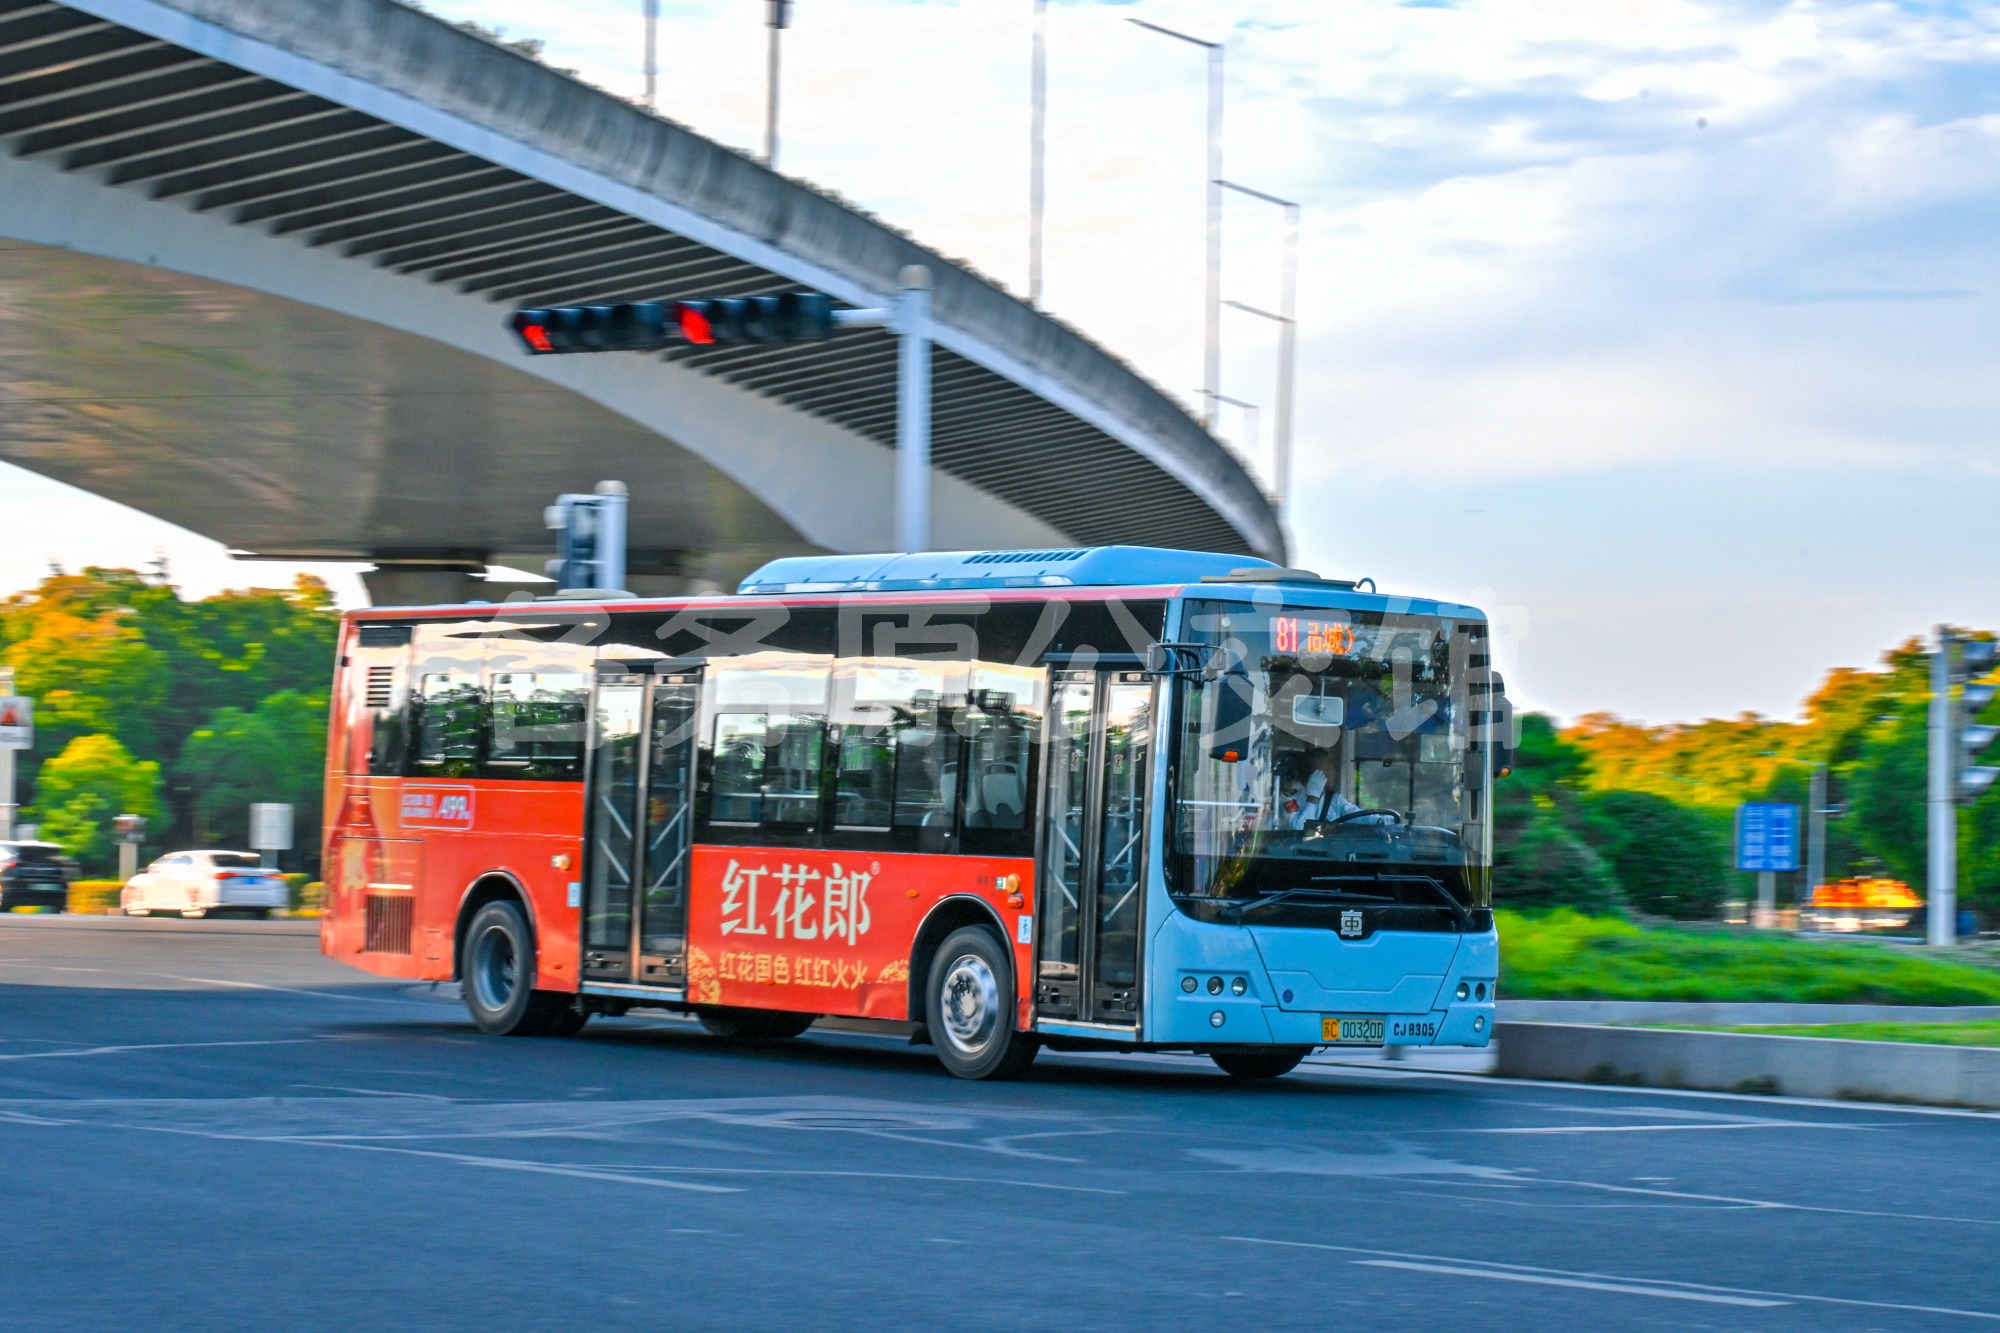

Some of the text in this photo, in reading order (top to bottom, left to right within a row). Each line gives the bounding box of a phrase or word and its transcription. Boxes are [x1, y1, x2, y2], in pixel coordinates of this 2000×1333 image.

[1276, 616, 1298, 653] 81
[720, 859, 873, 945] 红花郎
[719, 951, 868, 989] 红花国色 红红火火
[1393, 1022, 1435, 1037] CJ8305
